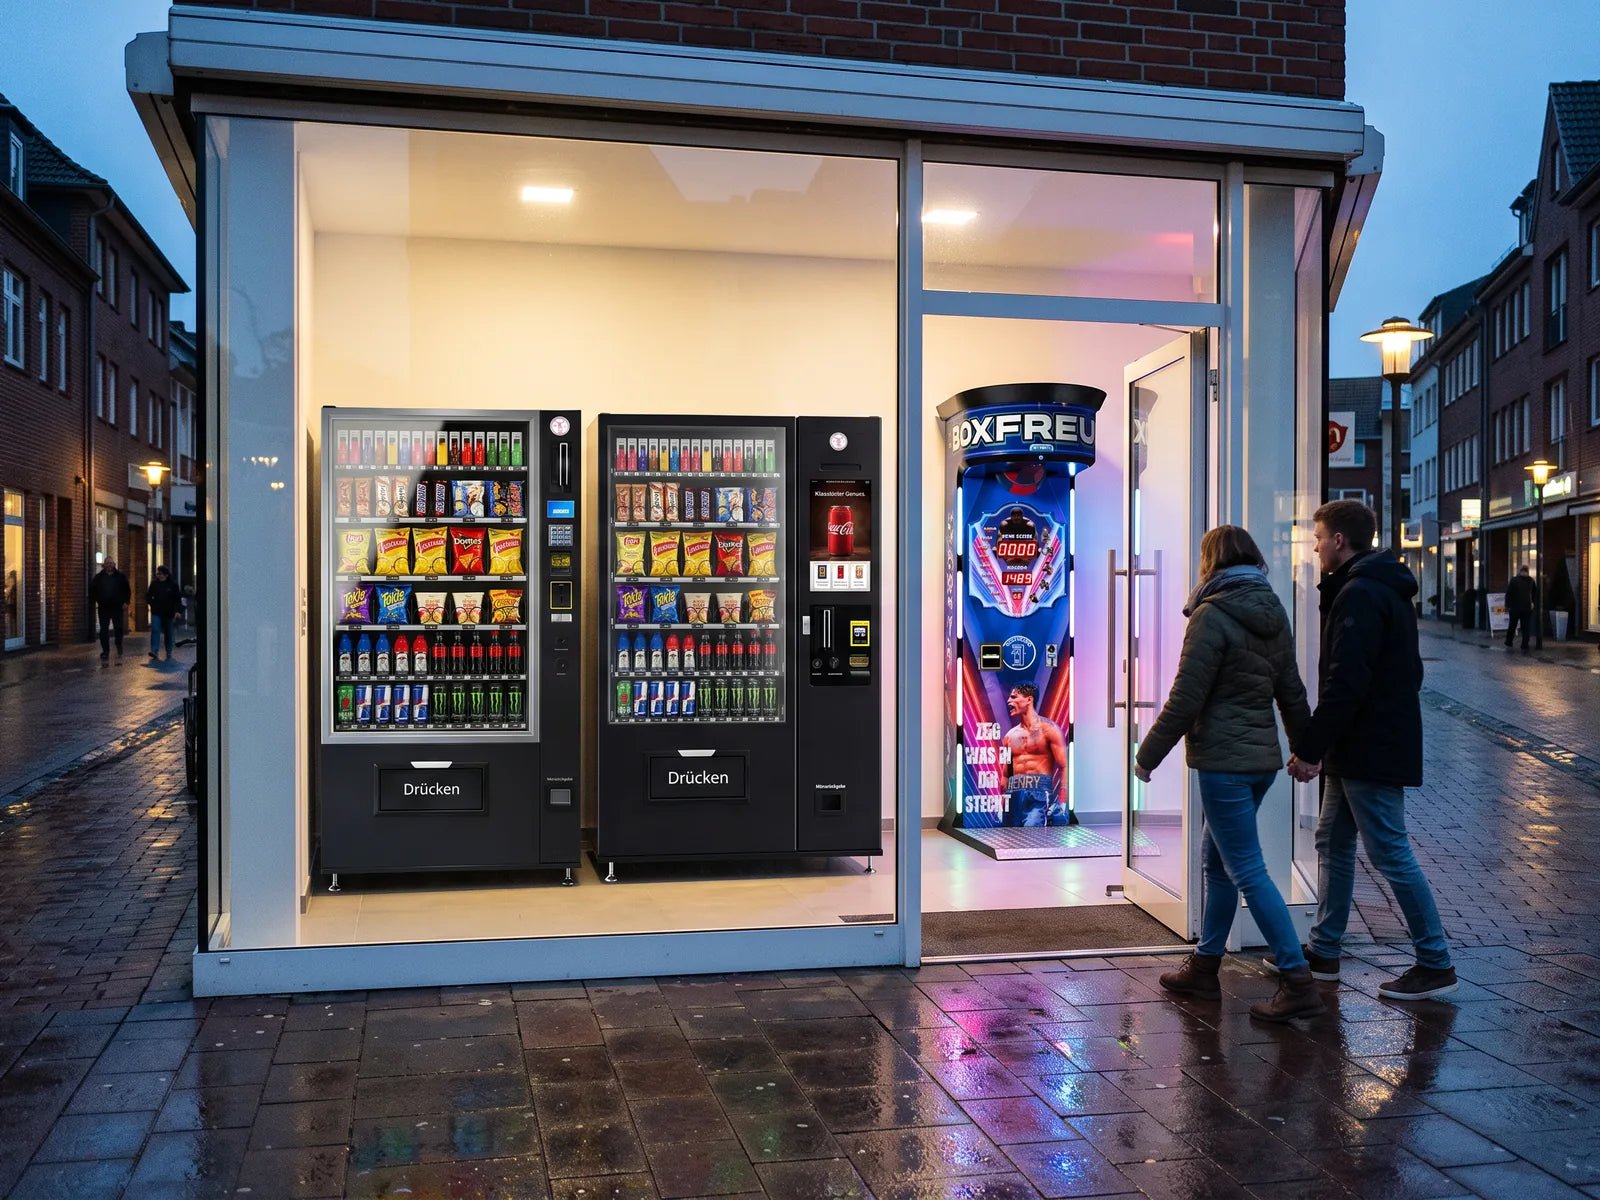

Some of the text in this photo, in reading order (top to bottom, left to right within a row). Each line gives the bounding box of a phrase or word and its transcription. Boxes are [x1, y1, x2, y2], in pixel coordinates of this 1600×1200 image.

[998, 543, 1036, 556] 0000
[1005, 573, 1032, 584] 1489
[668, 770, 729, 785] Drücken
[1008, 775, 1040, 789] HENRY
[403, 782, 460, 796] Drücken
